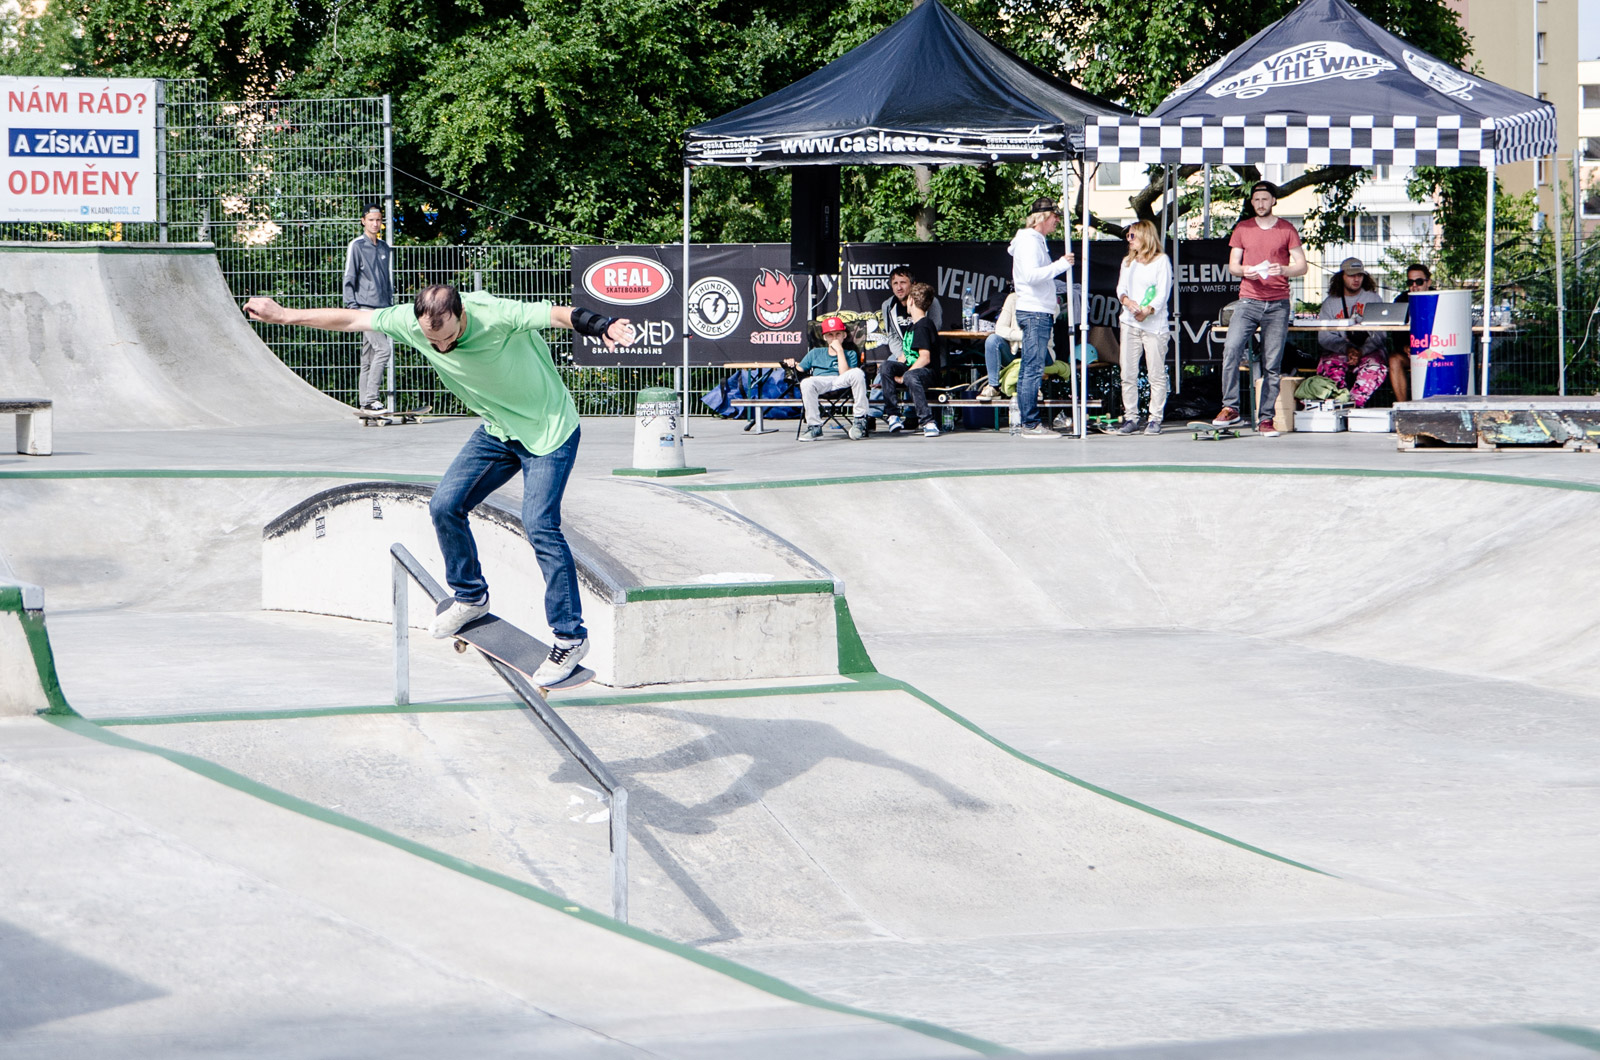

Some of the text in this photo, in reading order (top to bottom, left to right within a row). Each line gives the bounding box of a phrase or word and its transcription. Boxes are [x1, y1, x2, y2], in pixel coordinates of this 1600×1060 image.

[1263, 45, 1327, 71] VANS
[1269, 59, 1315, 82] THE
[8, 85, 147, 114] NÁM RÁD?
[13, 130, 134, 155] A ZÍSKÁVEJ
[780, 132, 961, 153] www.caskate.cz
[8, 163, 139, 196] ODMĚNY
[90, 206, 140, 215] KLADNOCOOL.CZ
[604, 268, 651, 286] REAL
[849, 264, 909, 275] VENTU
[695, 283, 731, 297] THUNDER
[1202, 284, 1226, 292] WATER
[696, 320, 722, 333] TRUCK
[751, 332, 801, 344] SPITFIRE
[1410, 334, 1457, 348] Red Bull
